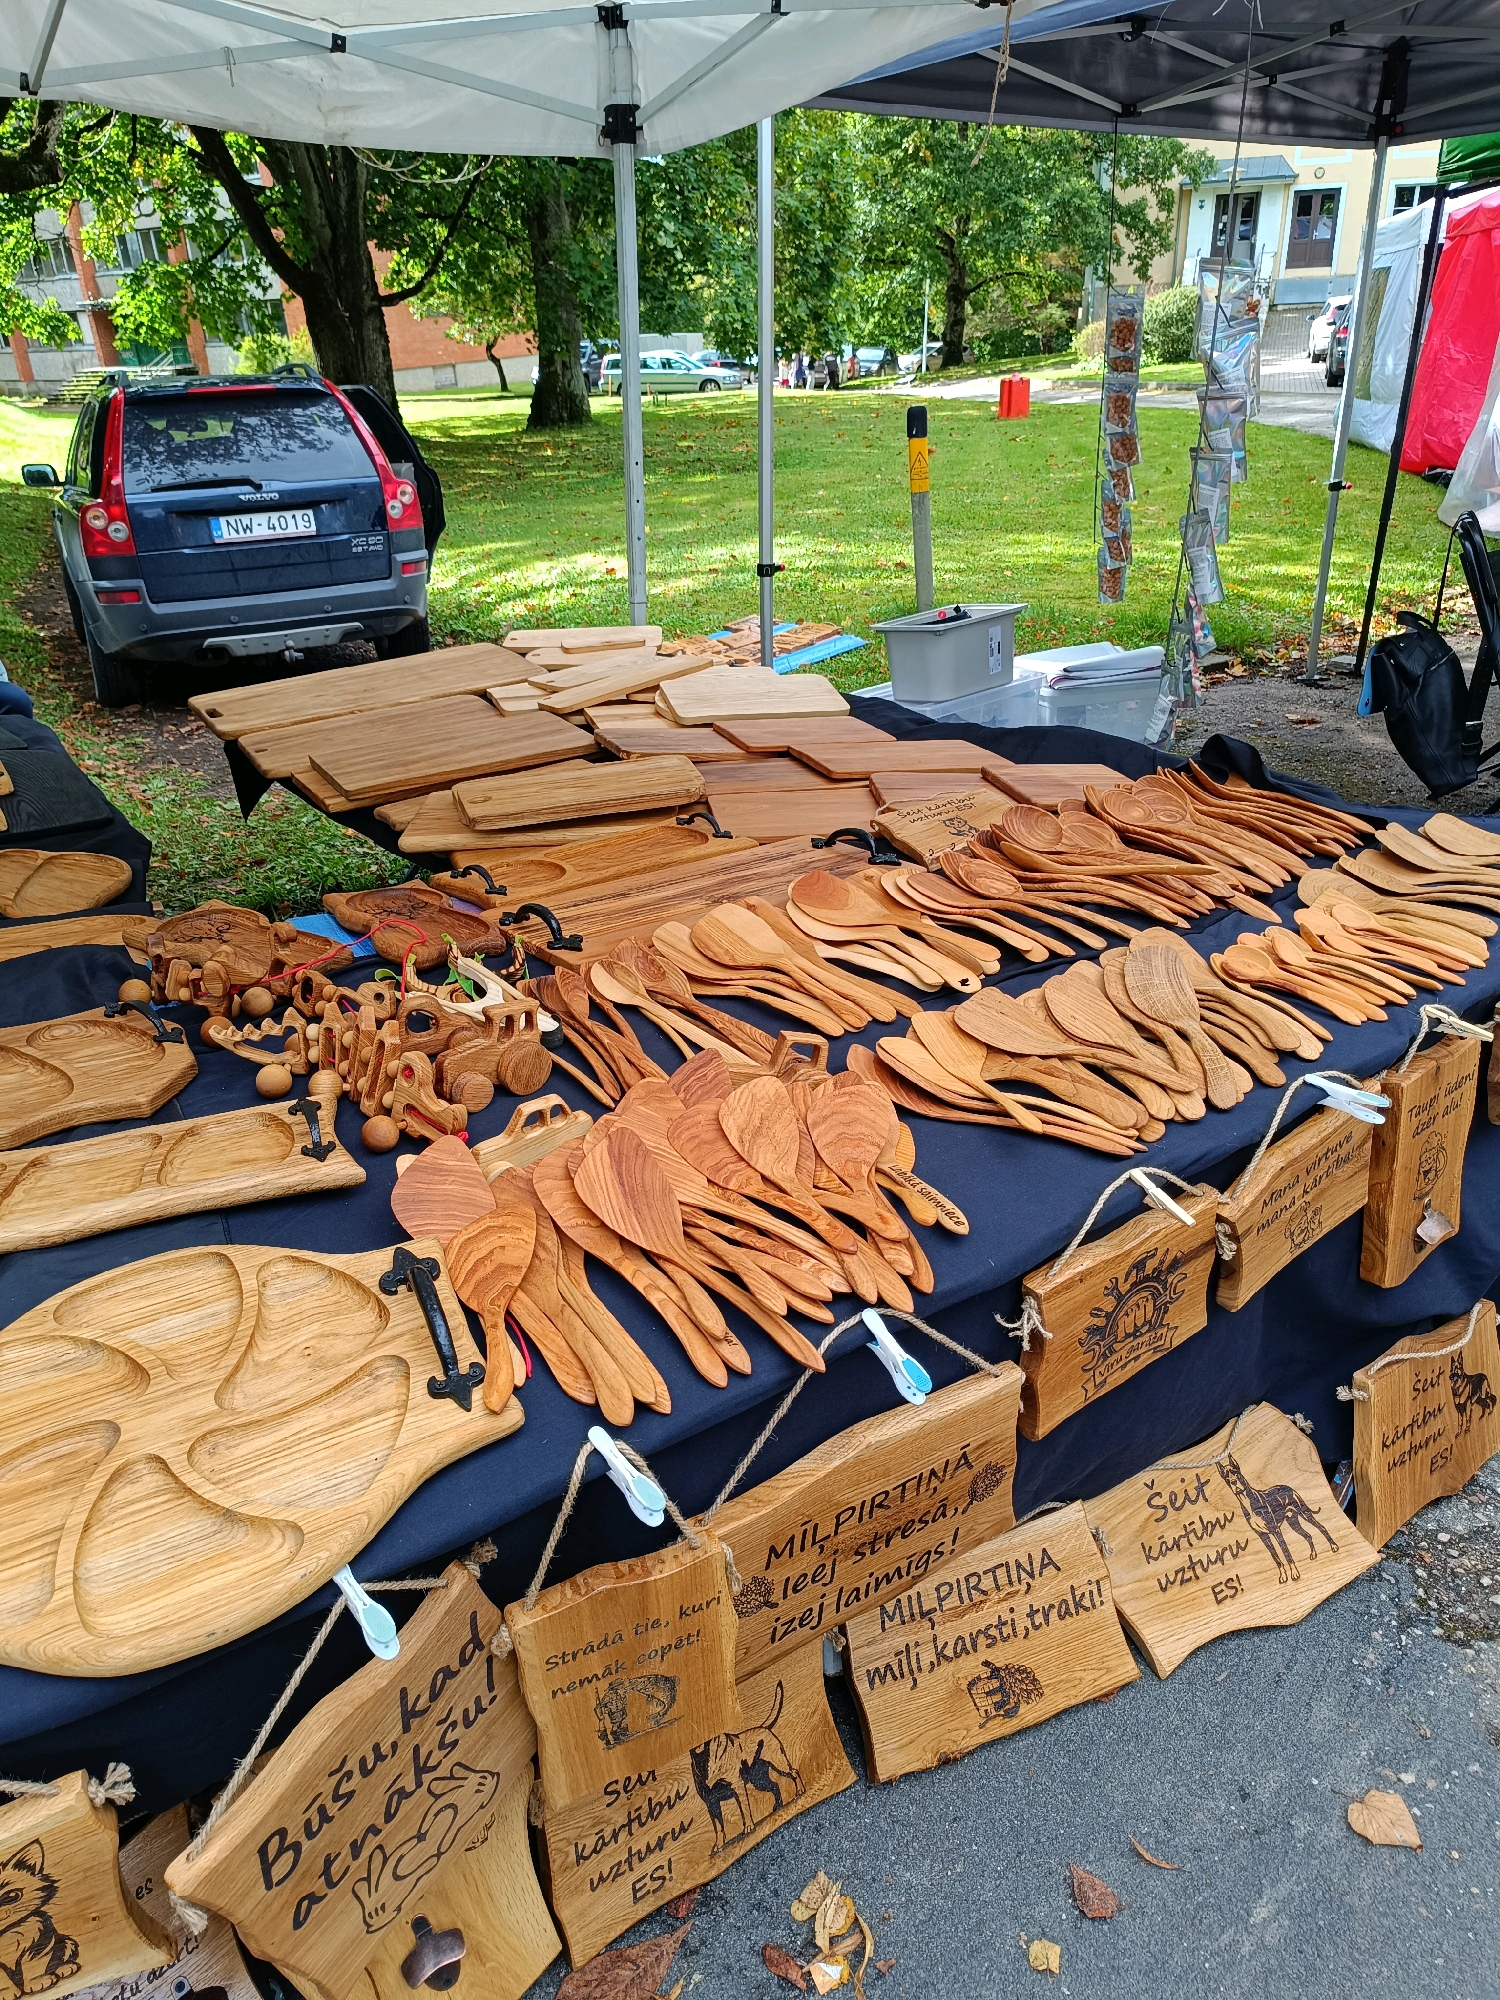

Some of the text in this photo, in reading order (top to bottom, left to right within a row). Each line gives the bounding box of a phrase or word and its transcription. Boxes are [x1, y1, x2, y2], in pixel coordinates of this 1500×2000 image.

[238, 492, 280, 502] VOLVO
[225, 512, 312, 537] NW-4019
[955, 802, 977, 812] ES!
[1407, 1086, 1442, 1123] Taupi
[1412, 1091, 1464, 1139] dzer alu!
[916, 1187, 966, 1227] saimniece
[1256, 1196, 1296, 1236] mana
[1261, 1174, 1300, 1214] Mana
[1411, 1365, 1446, 1401] Šeit
[1381, 1401, 1447, 1454] kārtību
[1387, 1425, 1447, 1474] uzturu
[1430, 1443, 1453, 1475] ES!
[1145, 1473, 1211, 1523] Šeit
[852, 1496, 959, 1565] stresā,
[1141, 1510, 1235, 1564] kārtību
[770, 1526, 960, 1645] izej laimīgs!
[1157, 1537, 1249, 1593] uzturu
[1210, 1574, 1245, 1605] ES!
[545, 1629, 625, 1672] Strādā
[678, 1589, 722, 1621] kuri
[551, 1628, 701, 1700] nemāk copēt!
[292, 1654, 498, 1932] atnākšu!
[573, 1785, 690, 1867] kārtību
[589, 1816, 694, 1893] uzturu
[631, 1857, 673, 1905] ES!
